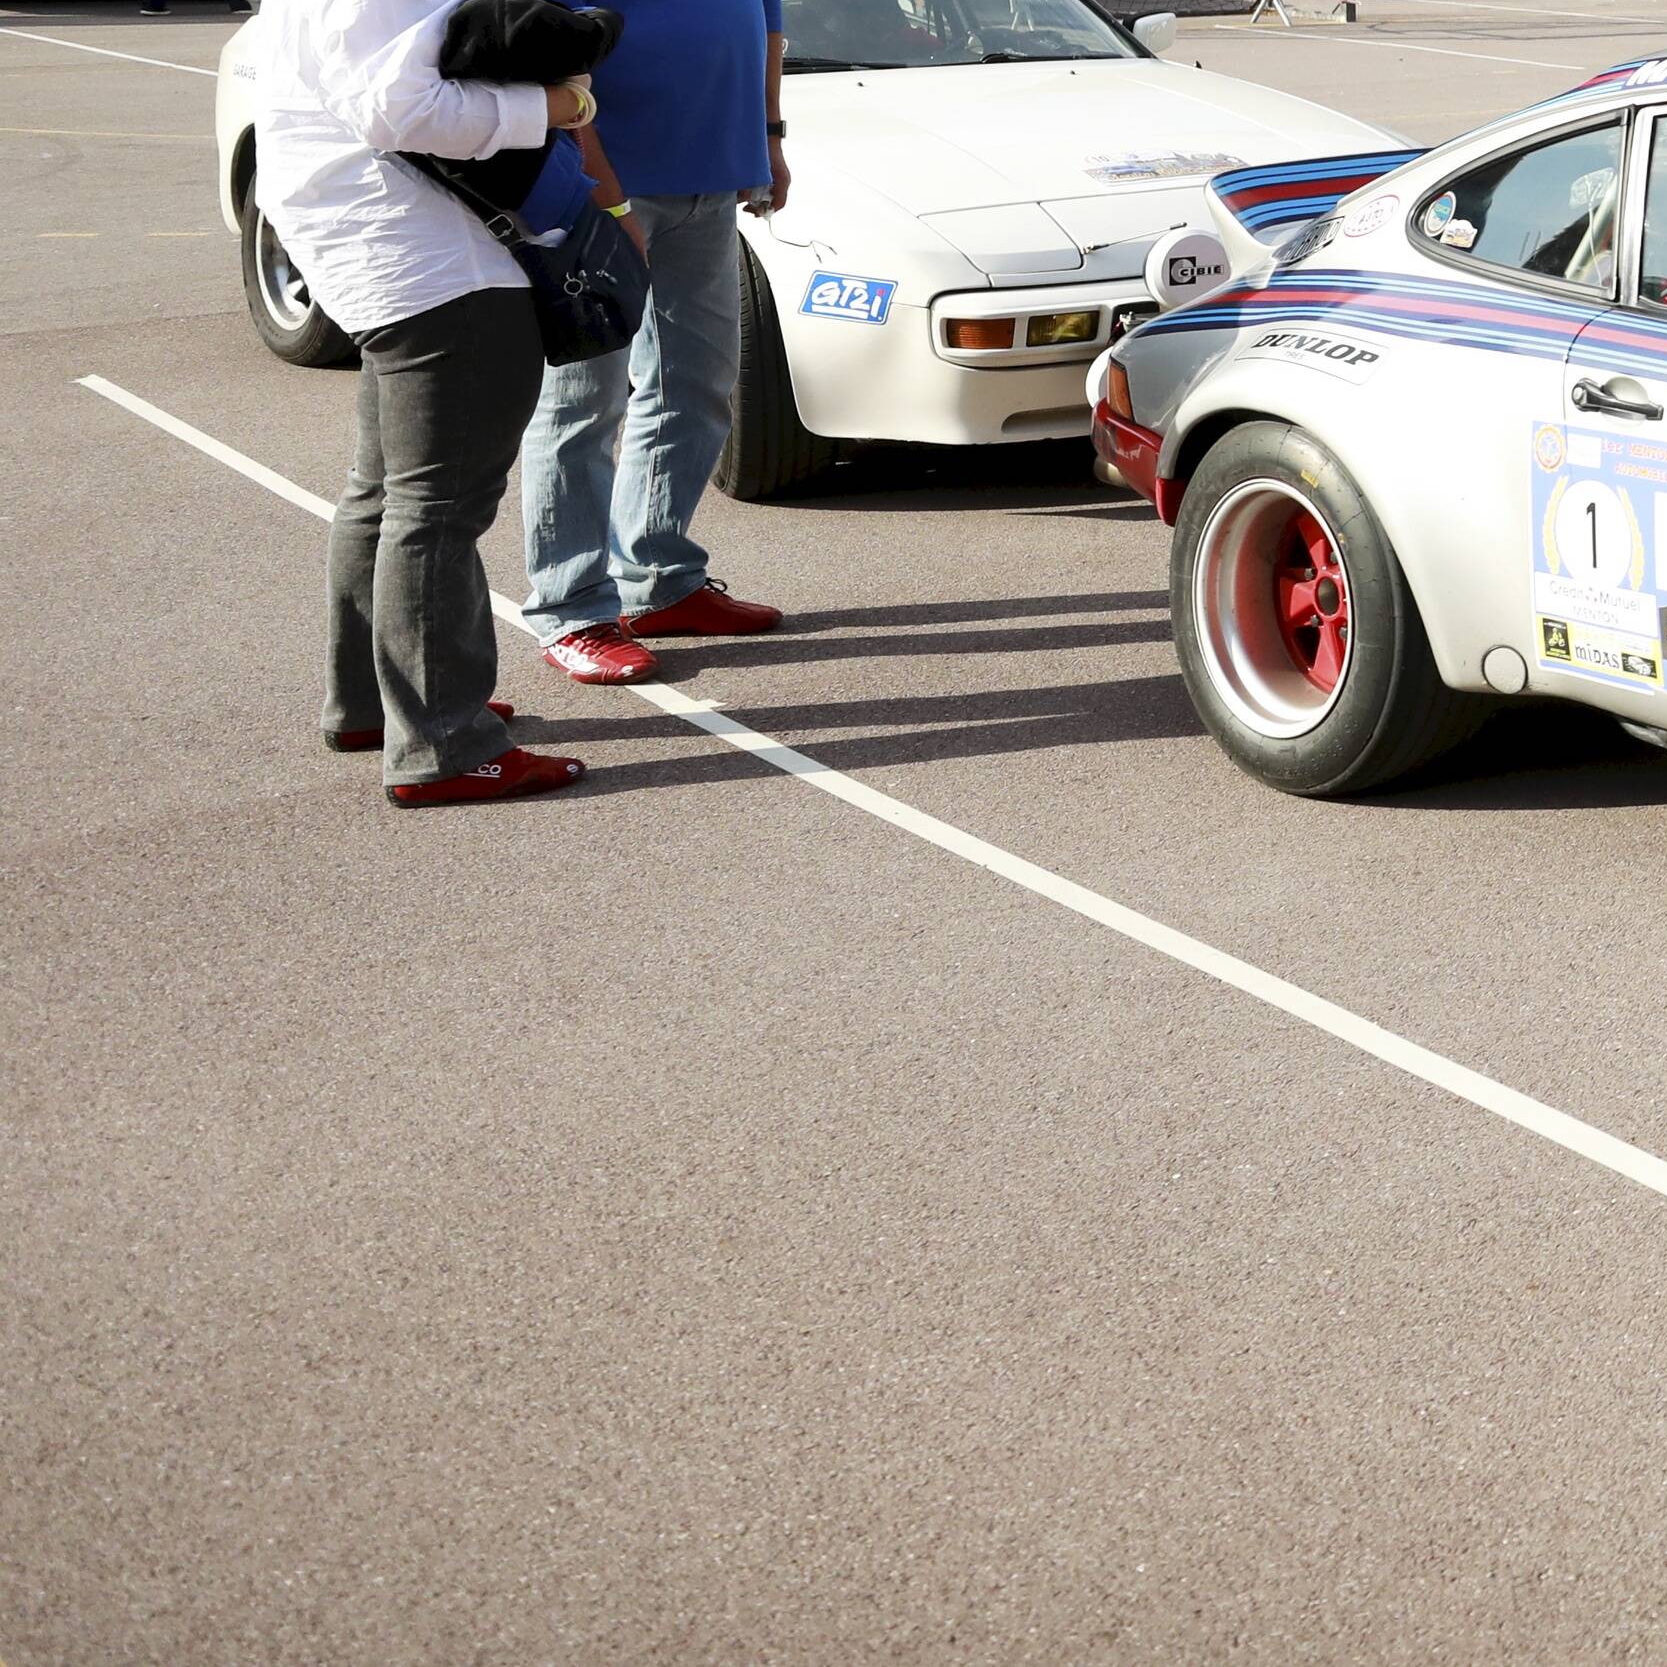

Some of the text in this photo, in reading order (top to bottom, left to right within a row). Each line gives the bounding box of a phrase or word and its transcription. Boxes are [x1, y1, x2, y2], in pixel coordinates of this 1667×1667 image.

[1179, 265, 1223, 277] CIBIE
[1251, 334, 1380, 366] DUNLOP
[1586, 502, 1597, 569] 1
